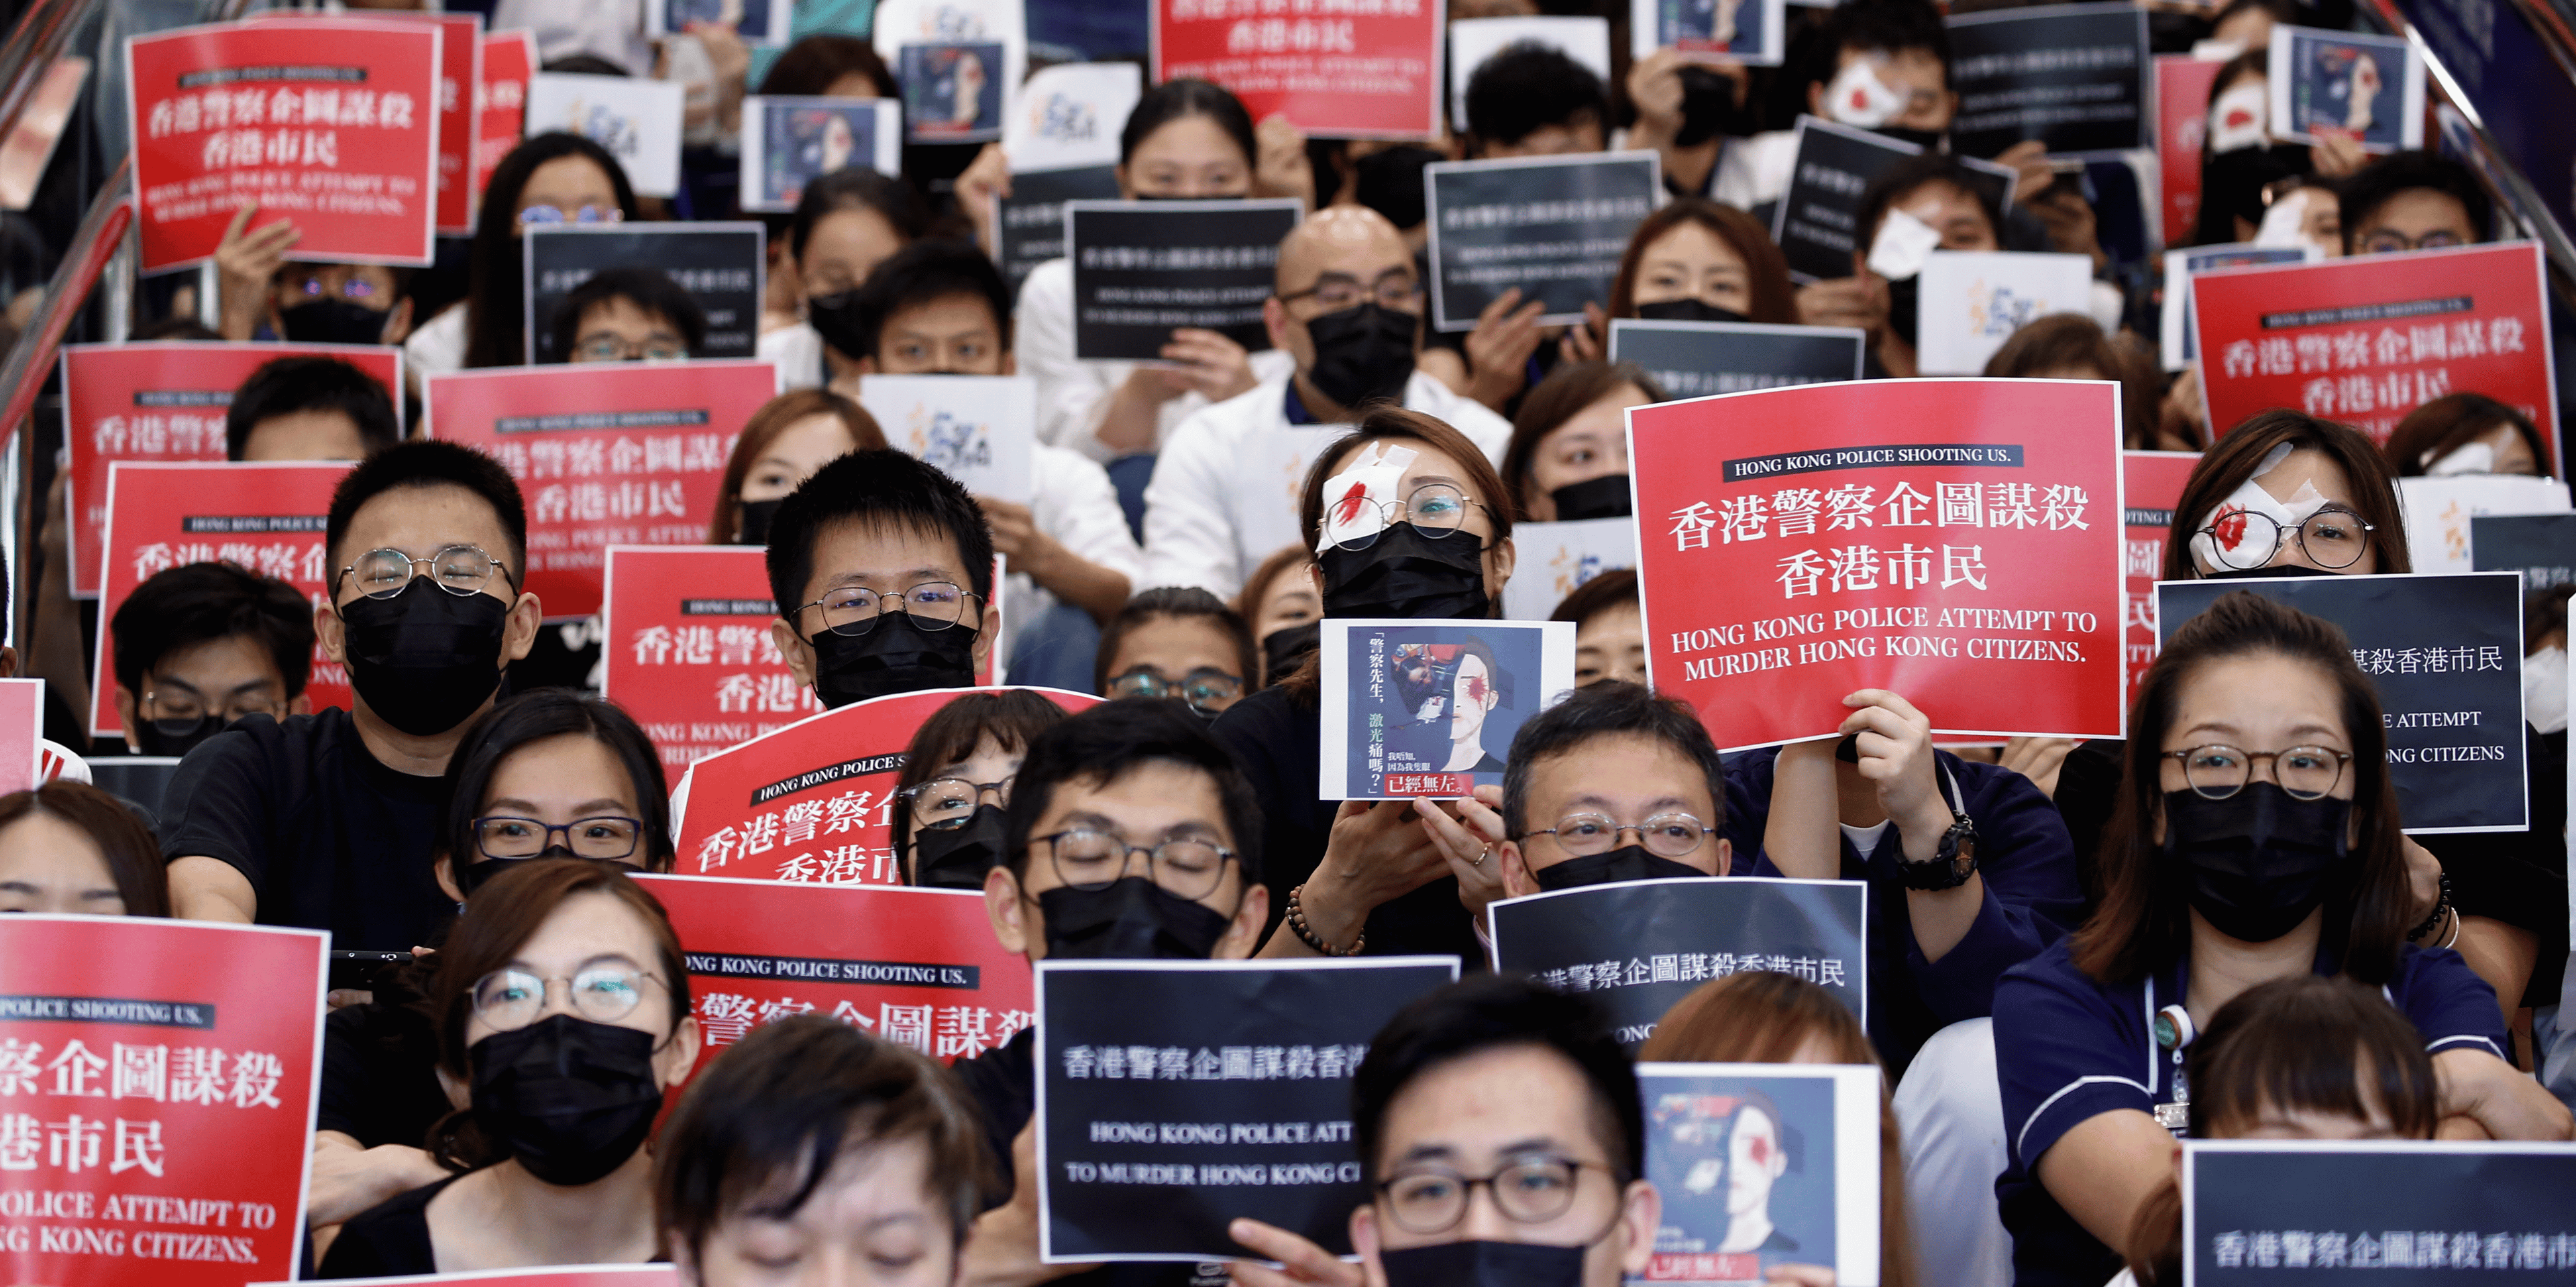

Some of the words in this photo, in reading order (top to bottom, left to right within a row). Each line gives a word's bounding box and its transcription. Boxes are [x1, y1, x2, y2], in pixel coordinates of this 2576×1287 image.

[1735, 459, 1782, 477] HONG
[1786, 453, 1831, 471] KONG
[1835, 449, 1894, 466] POLICE
[1898, 447, 1982, 463] SHOOTING
[1987, 449, 2012, 463] US.
[1668, 480, 2090, 552] 香港警察企圖謀殺
[1776, 543, 1988, 599] 香港市民
[1671, 623, 1746, 655] HONG
[1752, 612, 1826, 640] KONG
[1833, 606, 1929, 630] POLICE
[1936, 608, 2055, 632] ATTEMPT
[2063, 611, 2097, 633] TO
[1684, 649, 1791, 682] MURDER
[1799, 636, 1877, 665] HONG
[1885, 636, 1959, 658] KONG
[1966, 638, 2087, 663] CITIZENS.
[2396, 711, 2481, 728] ATTEMPT
[2420, 745, 2505, 763] CITIZENS
[759, 777, 798, 801] HONG
[801, 767, 839, 787] KONG
[842, 756, 894, 776] POLICE
[722, 958, 771, 975] KONG
[775, 961, 840, 979] POLICE
[843, 963, 936, 983] SHOOTING
[941, 968, 967, 985] US.
[70, 1001, 171, 1023] SHOOTING
[1089, 1121, 1157, 1144] HONG
[1160, 1122, 1227, 1145] KONG
[1230, 1121, 1311, 1145] POLICE
[1064, 1161, 1097, 1183] TO
[1099, 1163, 1196, 1186] MURDER
[1199, 1164, 1267, 1186] HONG
[1271, 1163, 1335, 1186] KONG
[0, 1189, 95, 1221] OLICE
[101, 1193, 234, 1227] ATTEMPT
[237, 1202, 276, 1230] TO
[40, 1226, 125, 1257] KONG
[131, 1231, 259, 1265] CITIZENS.
